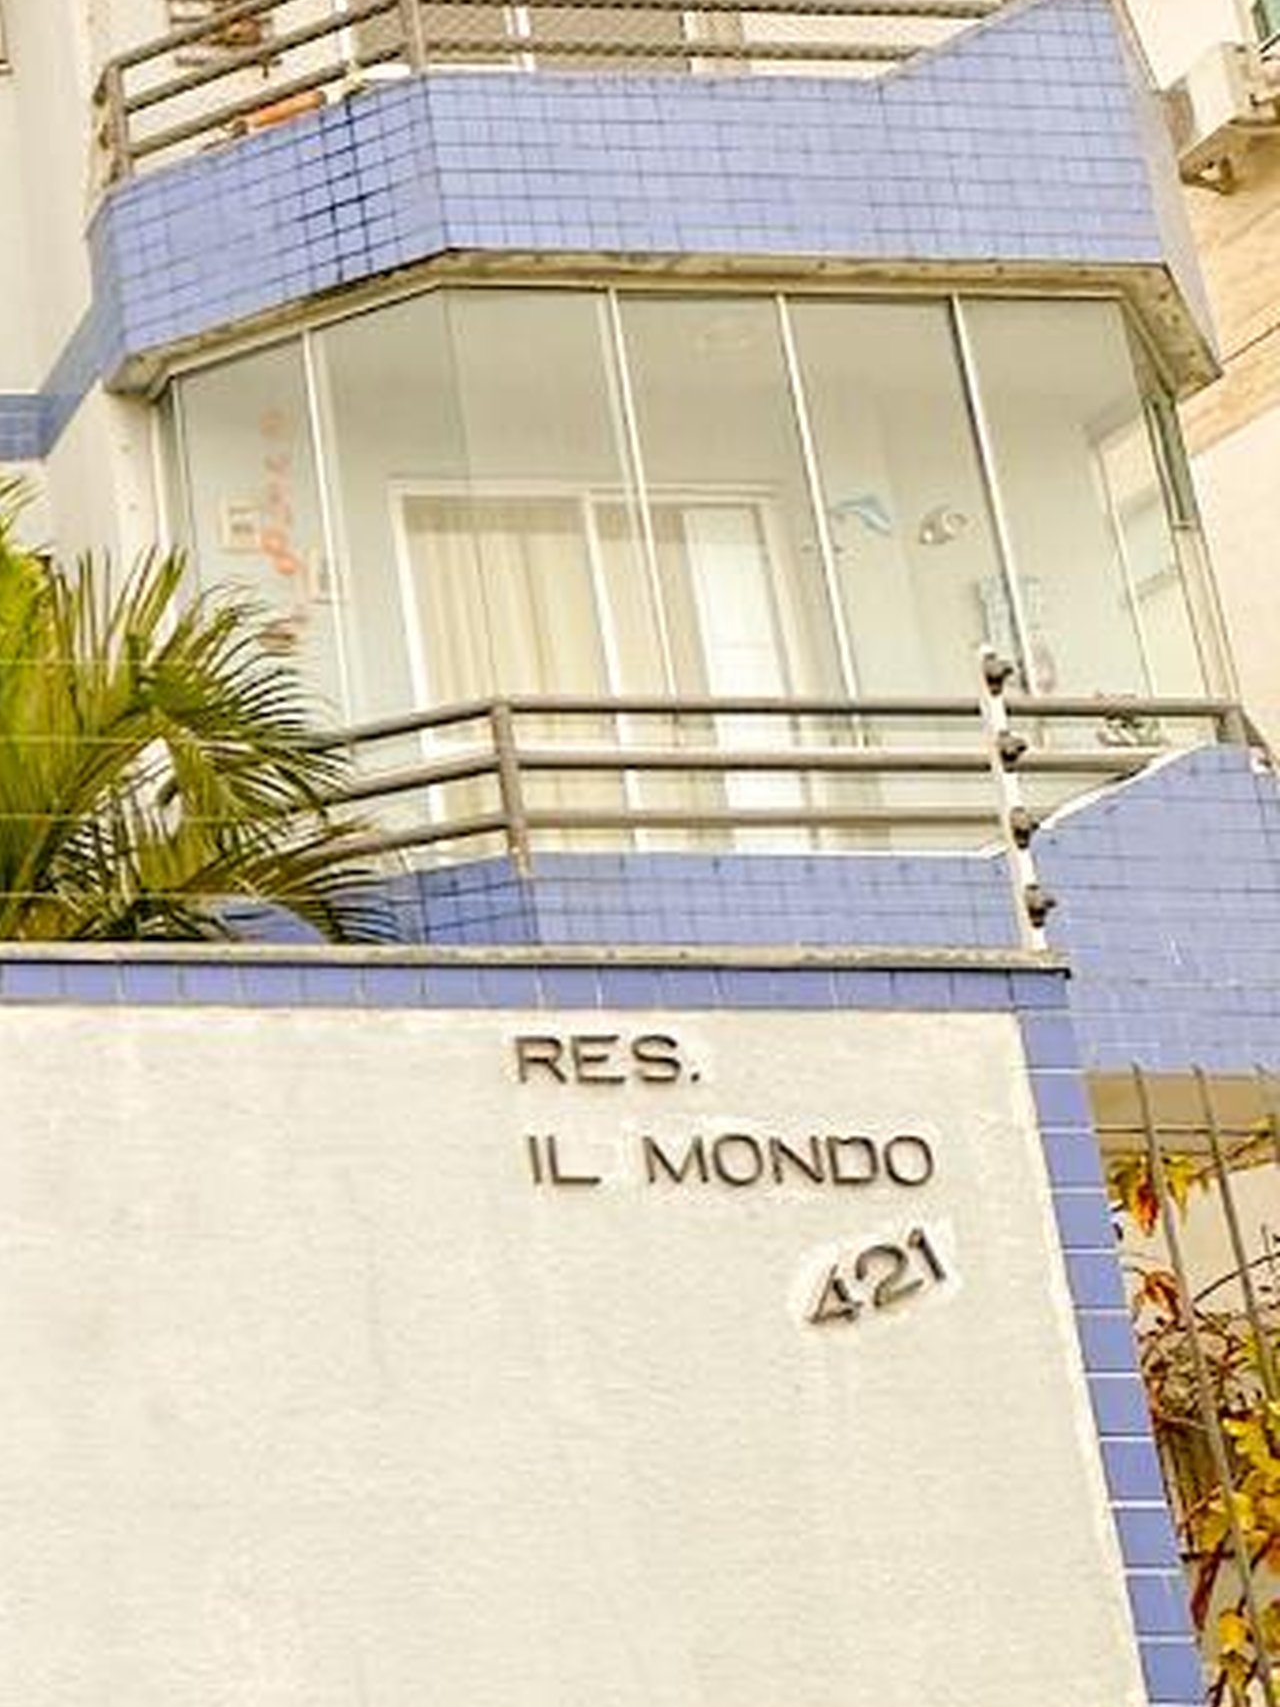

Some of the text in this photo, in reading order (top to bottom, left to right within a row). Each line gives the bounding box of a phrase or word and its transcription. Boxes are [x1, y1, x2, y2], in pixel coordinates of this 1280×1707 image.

[514, 1033, 701, 1086] RES.
[527, 1132, 934, 1188] IL MONDO
[808, 1228, 946, 1325] 421
